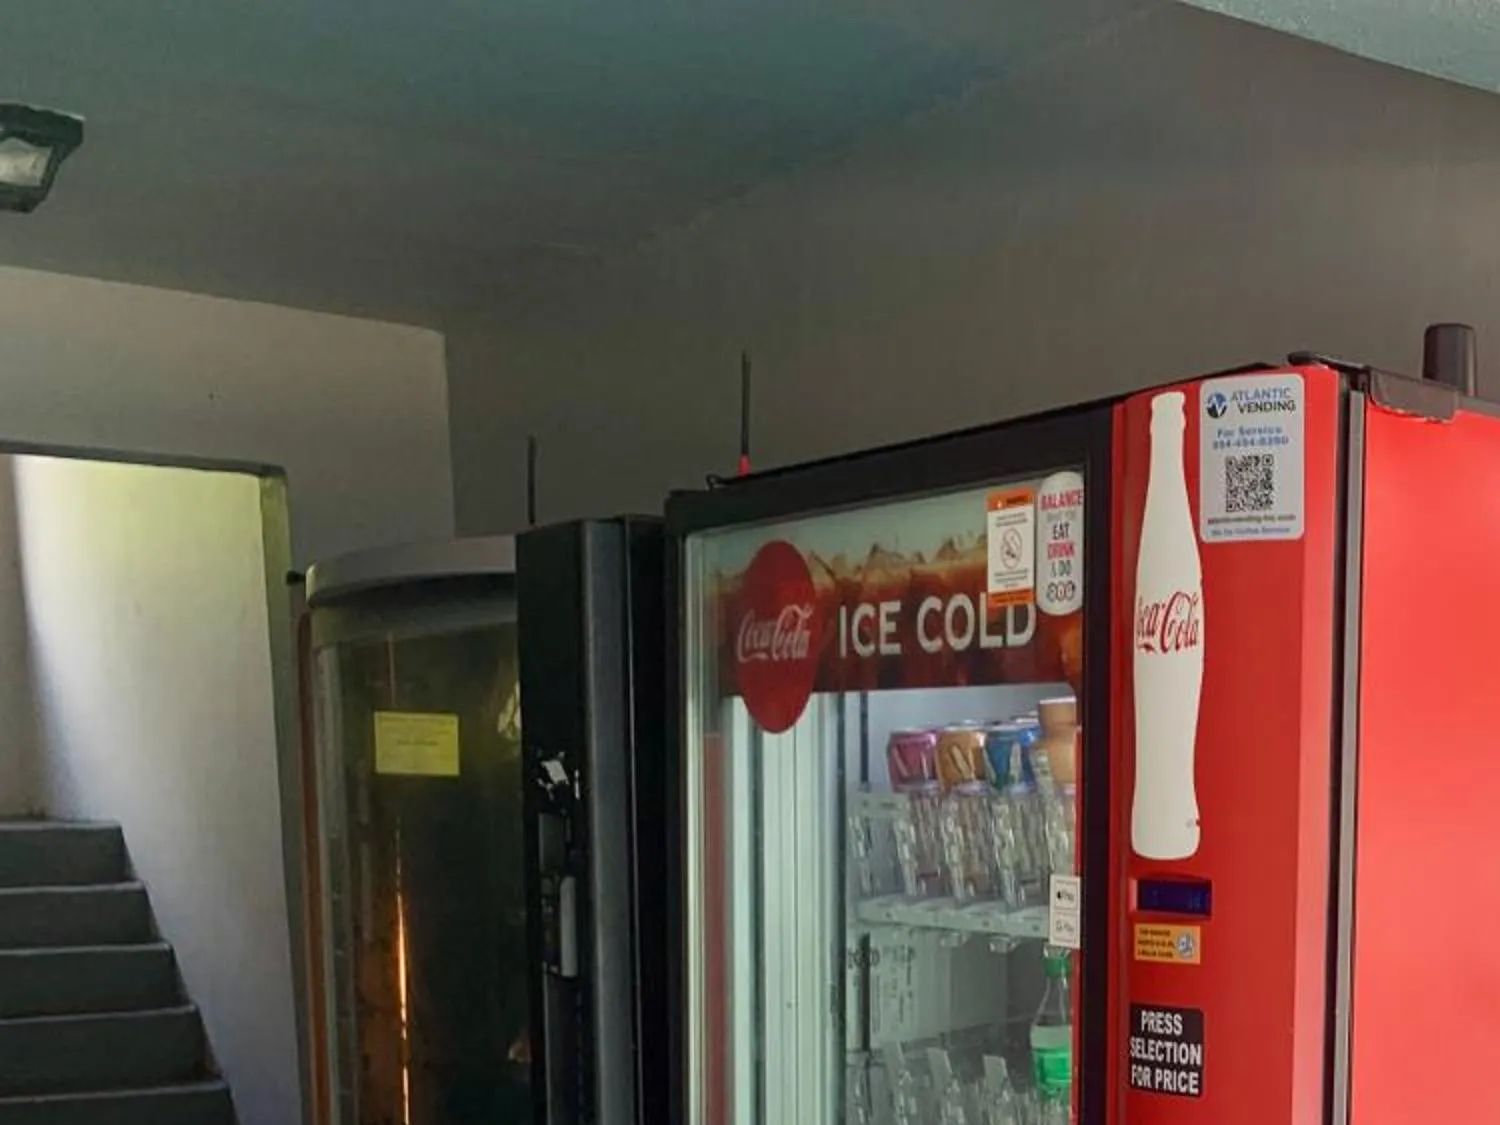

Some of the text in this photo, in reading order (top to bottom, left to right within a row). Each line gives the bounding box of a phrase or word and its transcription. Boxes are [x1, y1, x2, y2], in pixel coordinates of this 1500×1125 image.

[1231, 387, 1291, 401] ATLANTIC
[1237, 400, 1296, 415] VENDING
[1041, 489, 1083, 511] BALANCE
[1053, 521, 1070, 540] EAT
[1047, 541, 1076, 560] DRINK
[1058, 559, 1072, 577] DO
[737, 603, 814, 663] Coca-Cola
[839, 593, 1037, 658] ICE COLD
[1141, 1010, 1183, 1036] PRESS
[1130, 1036, 1202, 1066] SELECTION
[1131, 1065, 1200, 1095] FOR PRICE
